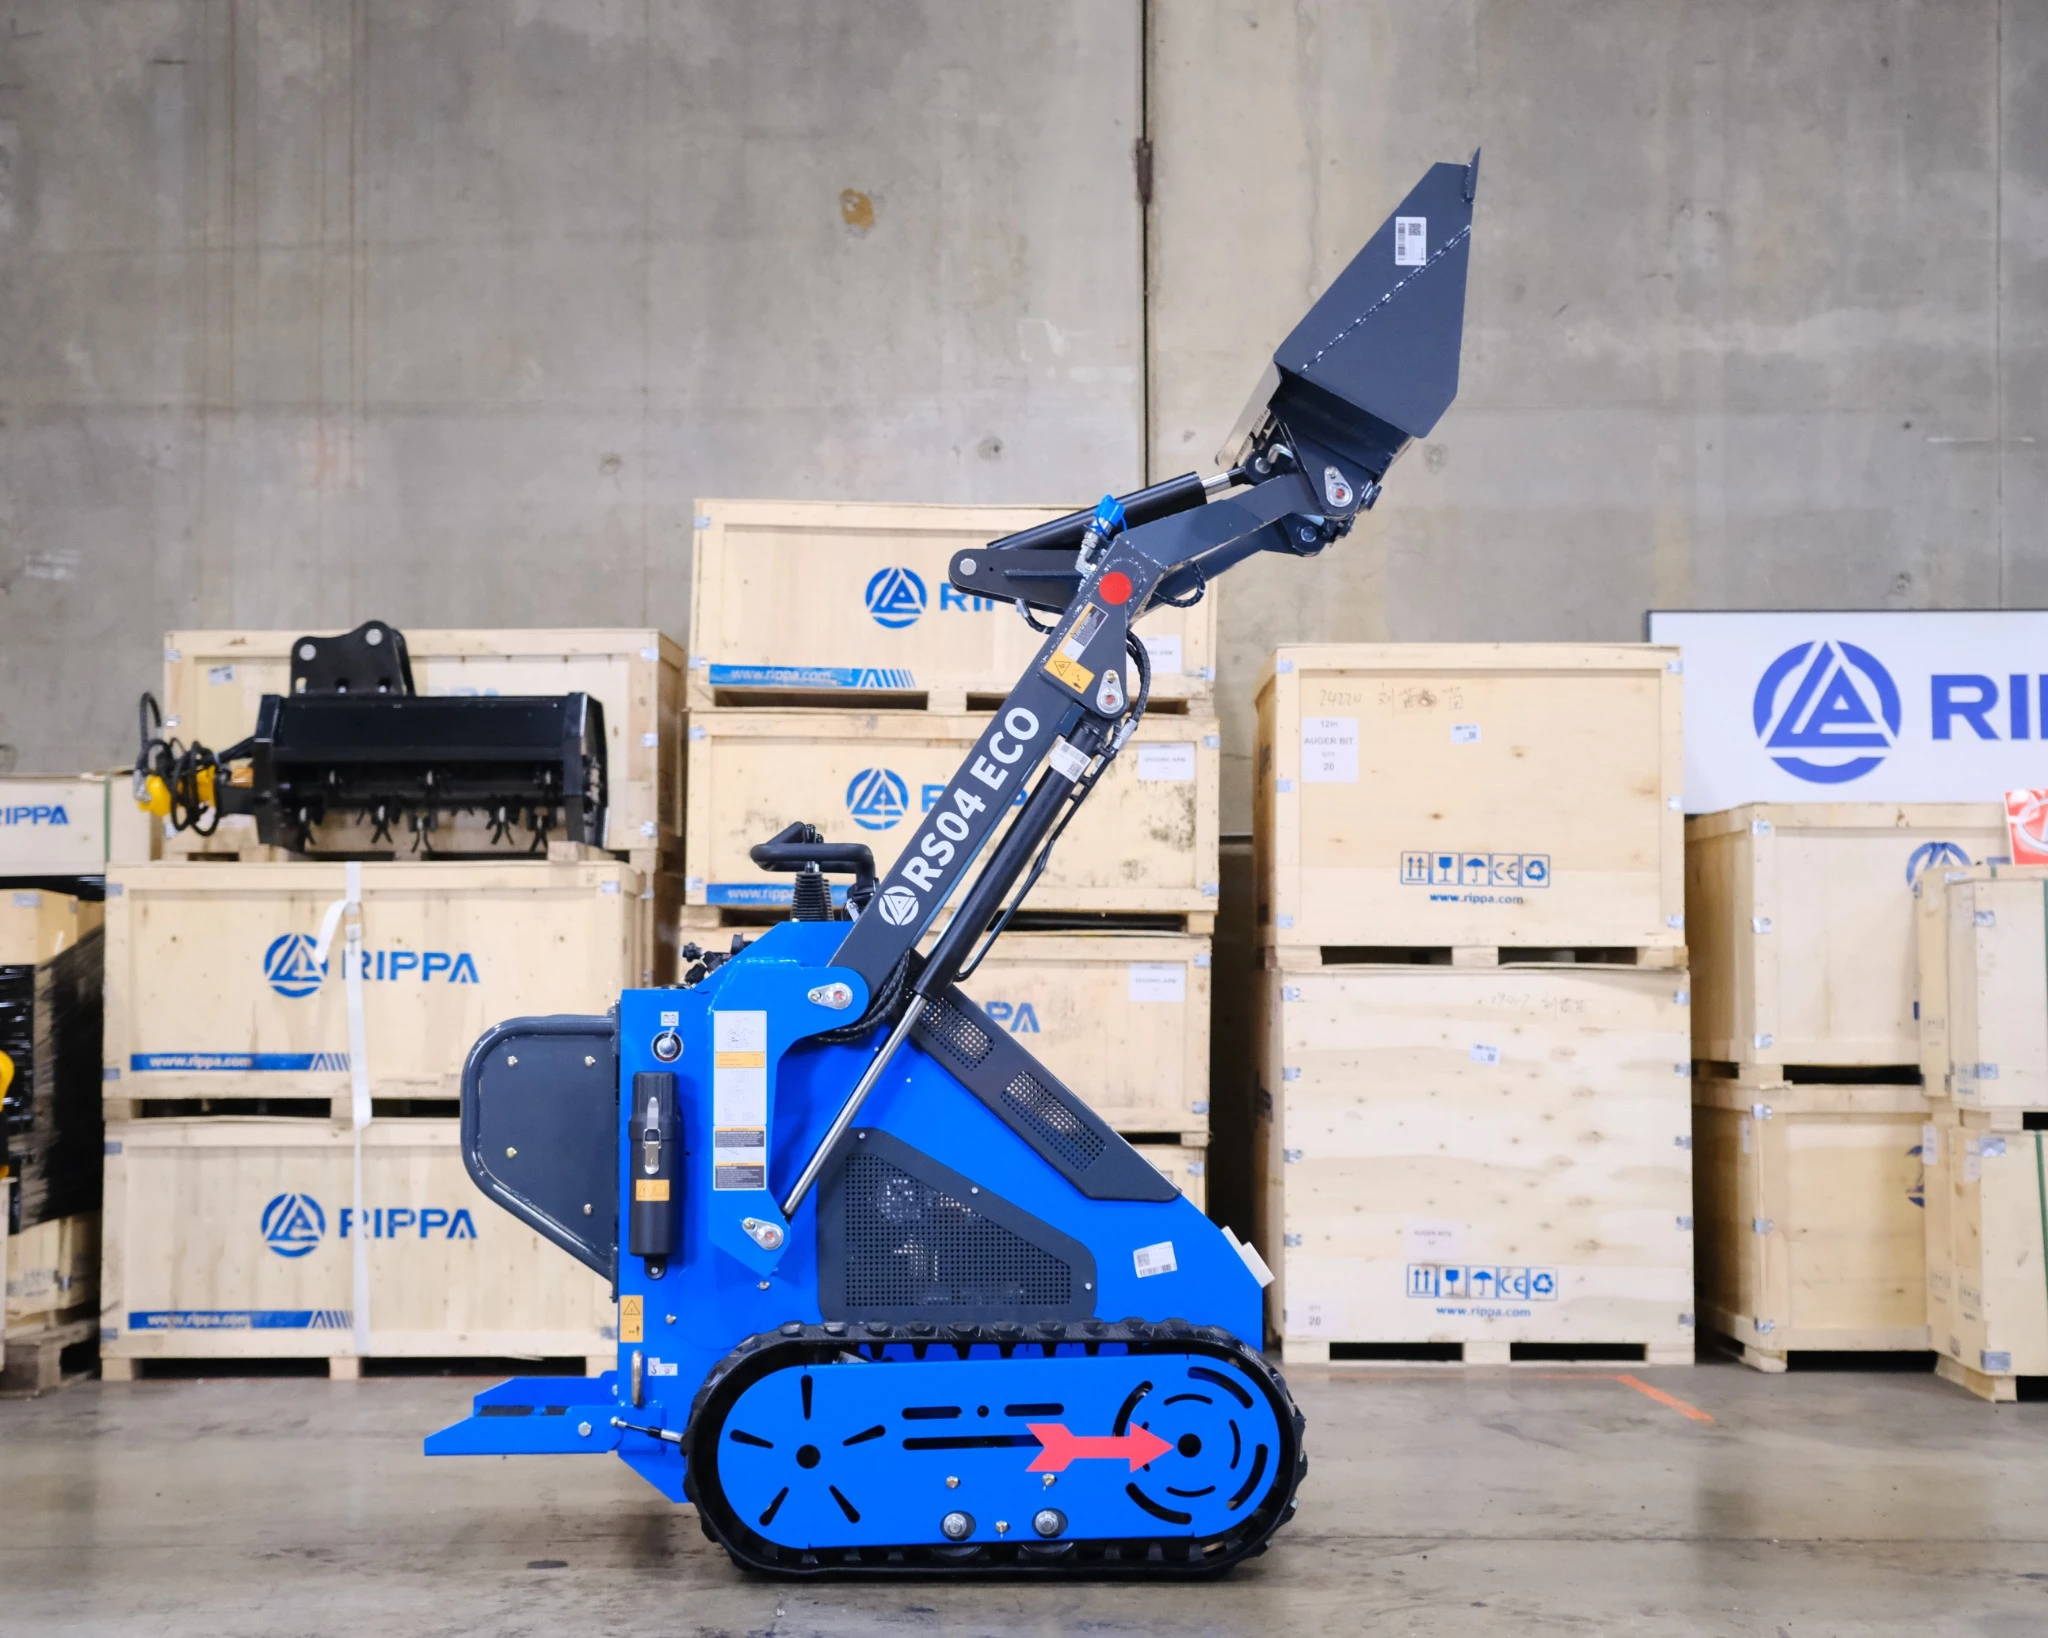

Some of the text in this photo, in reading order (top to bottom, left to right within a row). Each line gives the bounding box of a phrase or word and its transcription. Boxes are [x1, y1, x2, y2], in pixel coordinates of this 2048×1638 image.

[1323, 762, 1335, 771] 20
[901, 787, 987, 893] RS04
[969, 707, 1040, 791] ECO
[0, 805, 69, 825] IPPA
[1430, 893, 1524, 904] www.rippa.com
[150, 1055, 253, 1069] www.rippa.com
[1436, 1305, 1531, 1318] www.rippa.com
